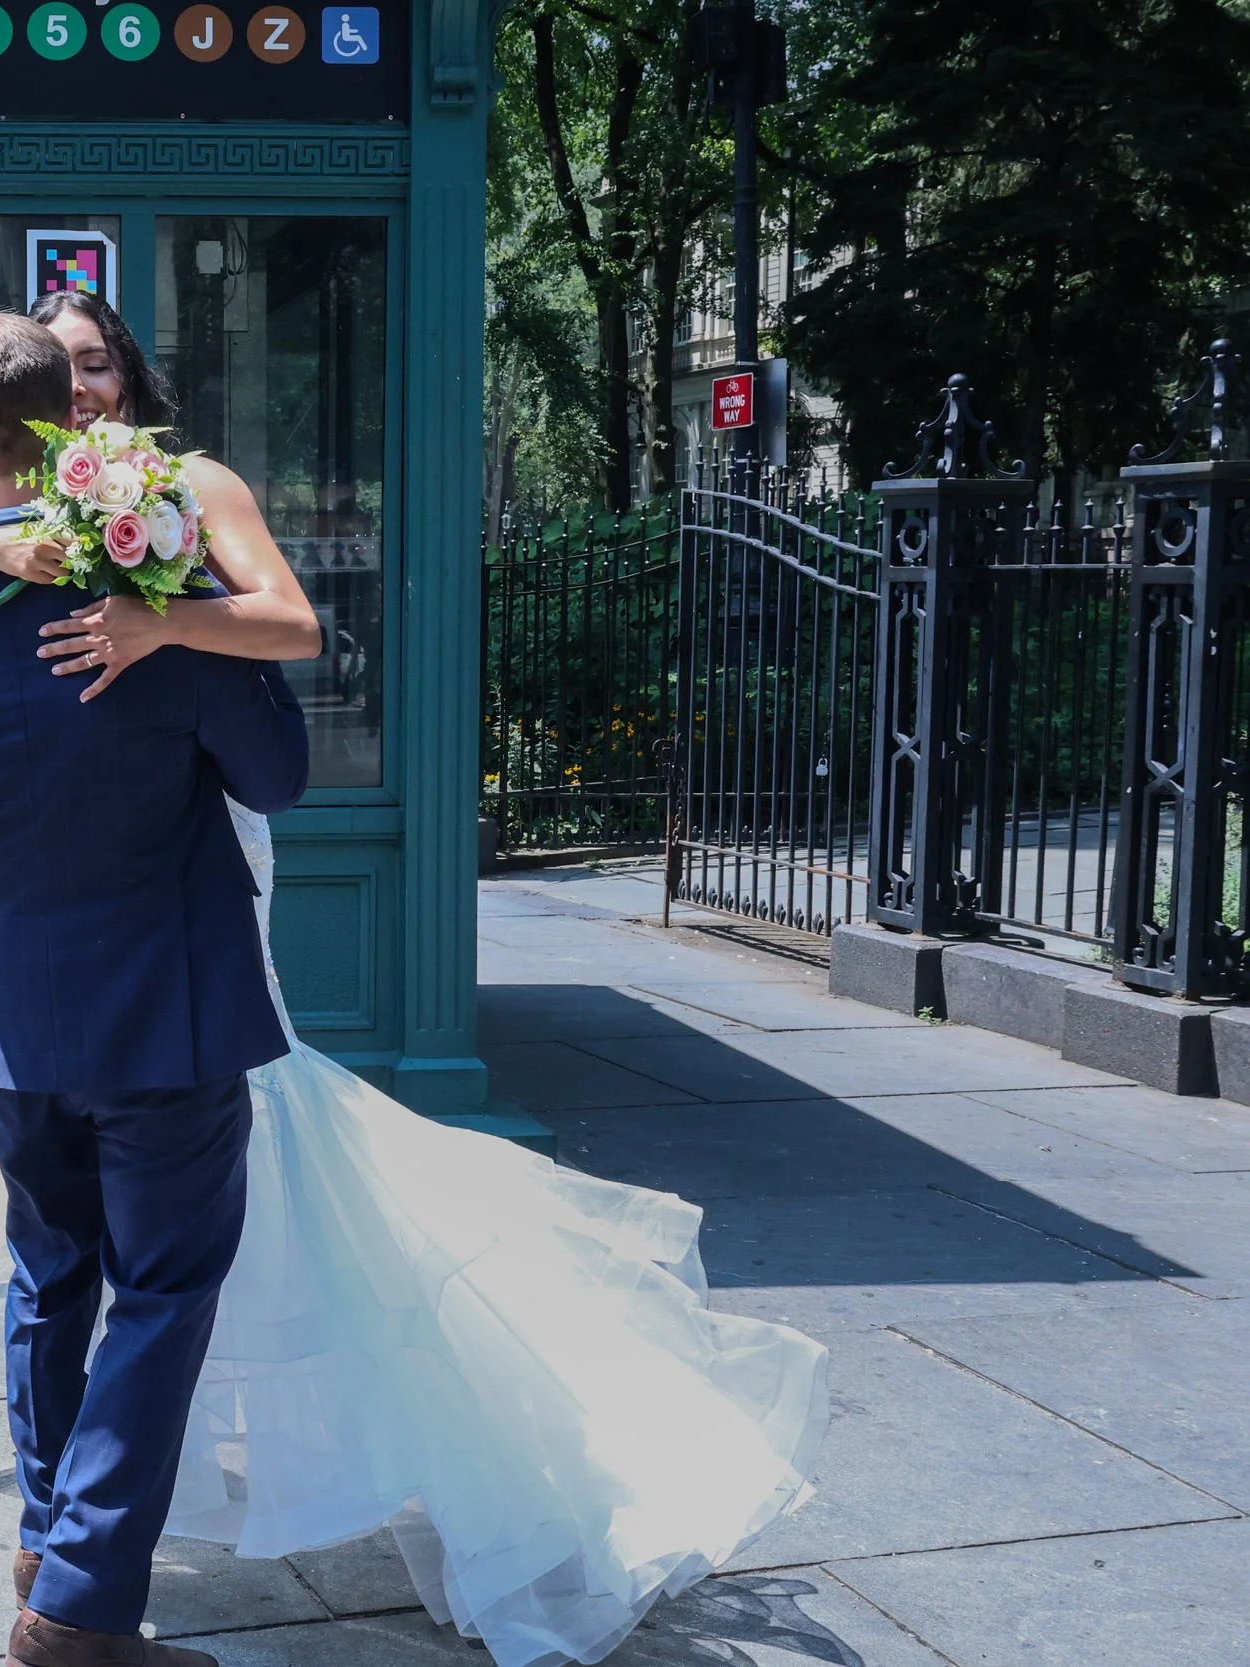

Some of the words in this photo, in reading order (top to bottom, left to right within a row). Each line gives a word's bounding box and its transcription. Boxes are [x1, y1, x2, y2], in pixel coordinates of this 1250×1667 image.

[46, 14, 69, 47] 5
[118, 16, 141, 48] 6
[192, 16, 214, 50] J
[263, 18, 290, 50] Z
[719, 394, 746, 410] WRONG
[723, 410, 741, 423] WAY
